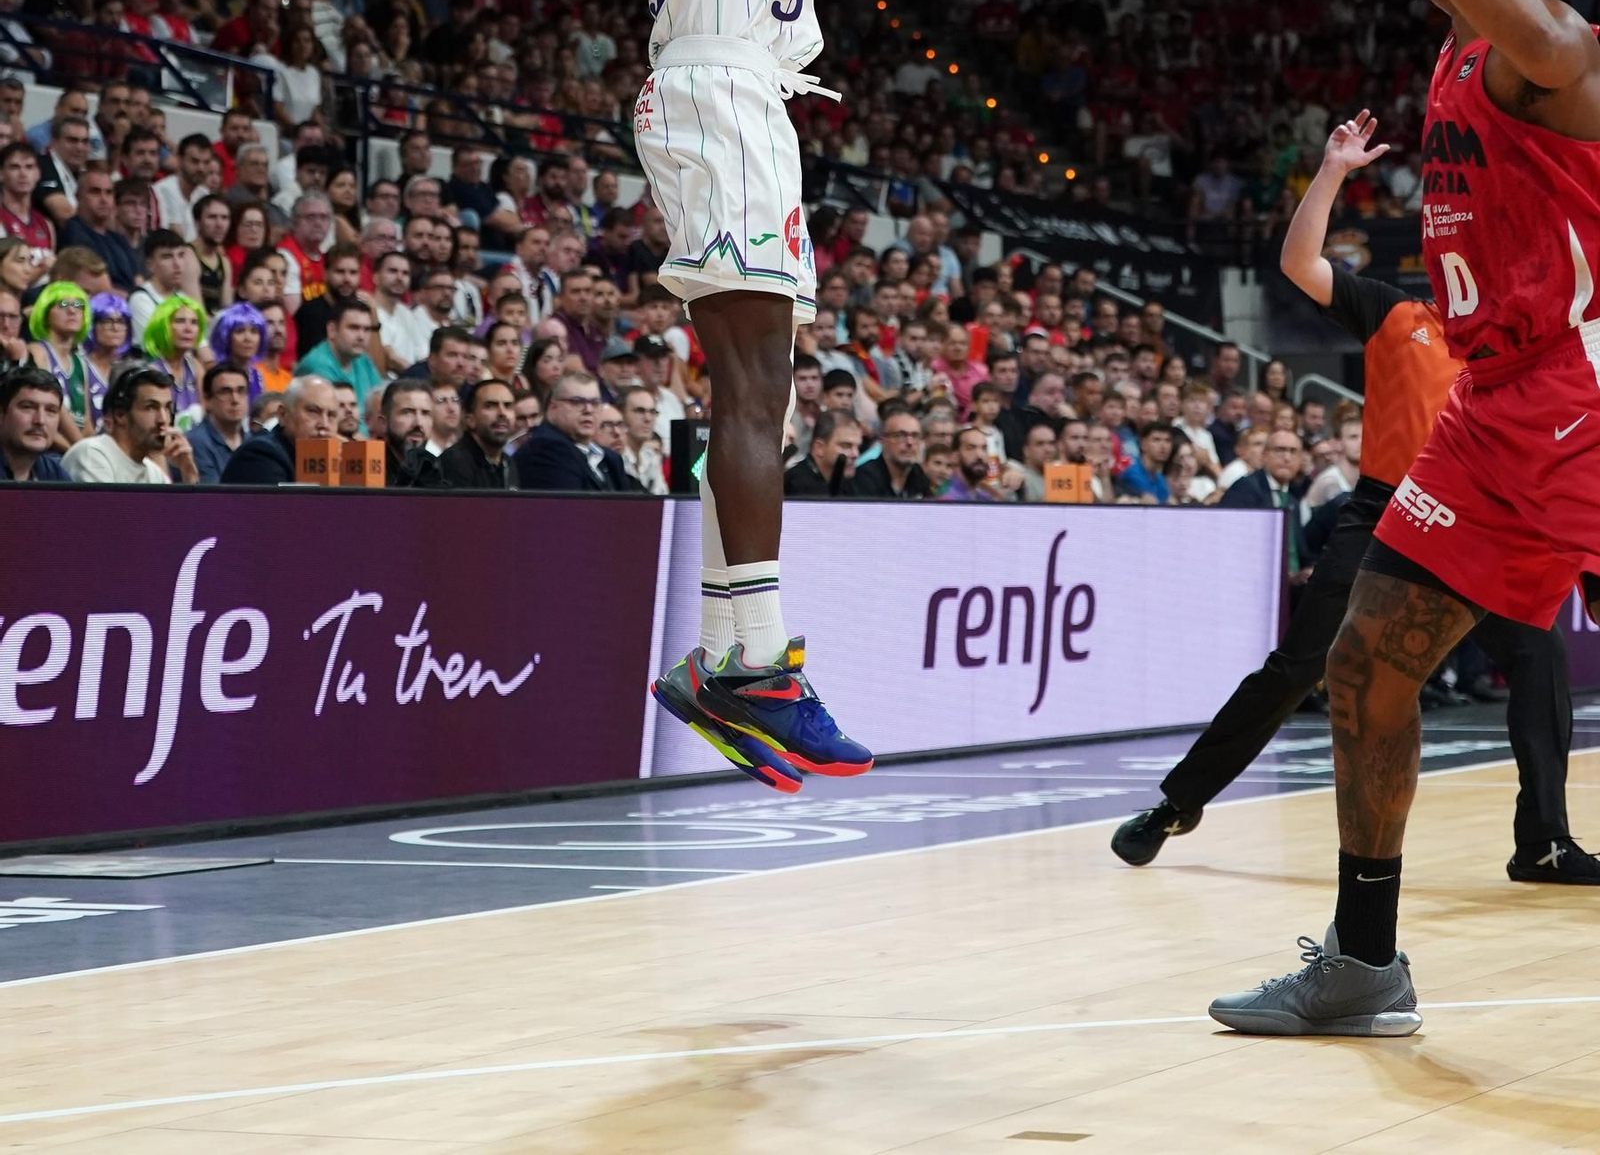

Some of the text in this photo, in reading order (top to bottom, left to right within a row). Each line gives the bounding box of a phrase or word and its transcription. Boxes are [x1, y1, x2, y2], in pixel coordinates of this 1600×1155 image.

[303, 458, 326, 474] IRS
[0, 537, 541, 785] enfe Tu tren
[923, 529, 1096, 715] renfe
